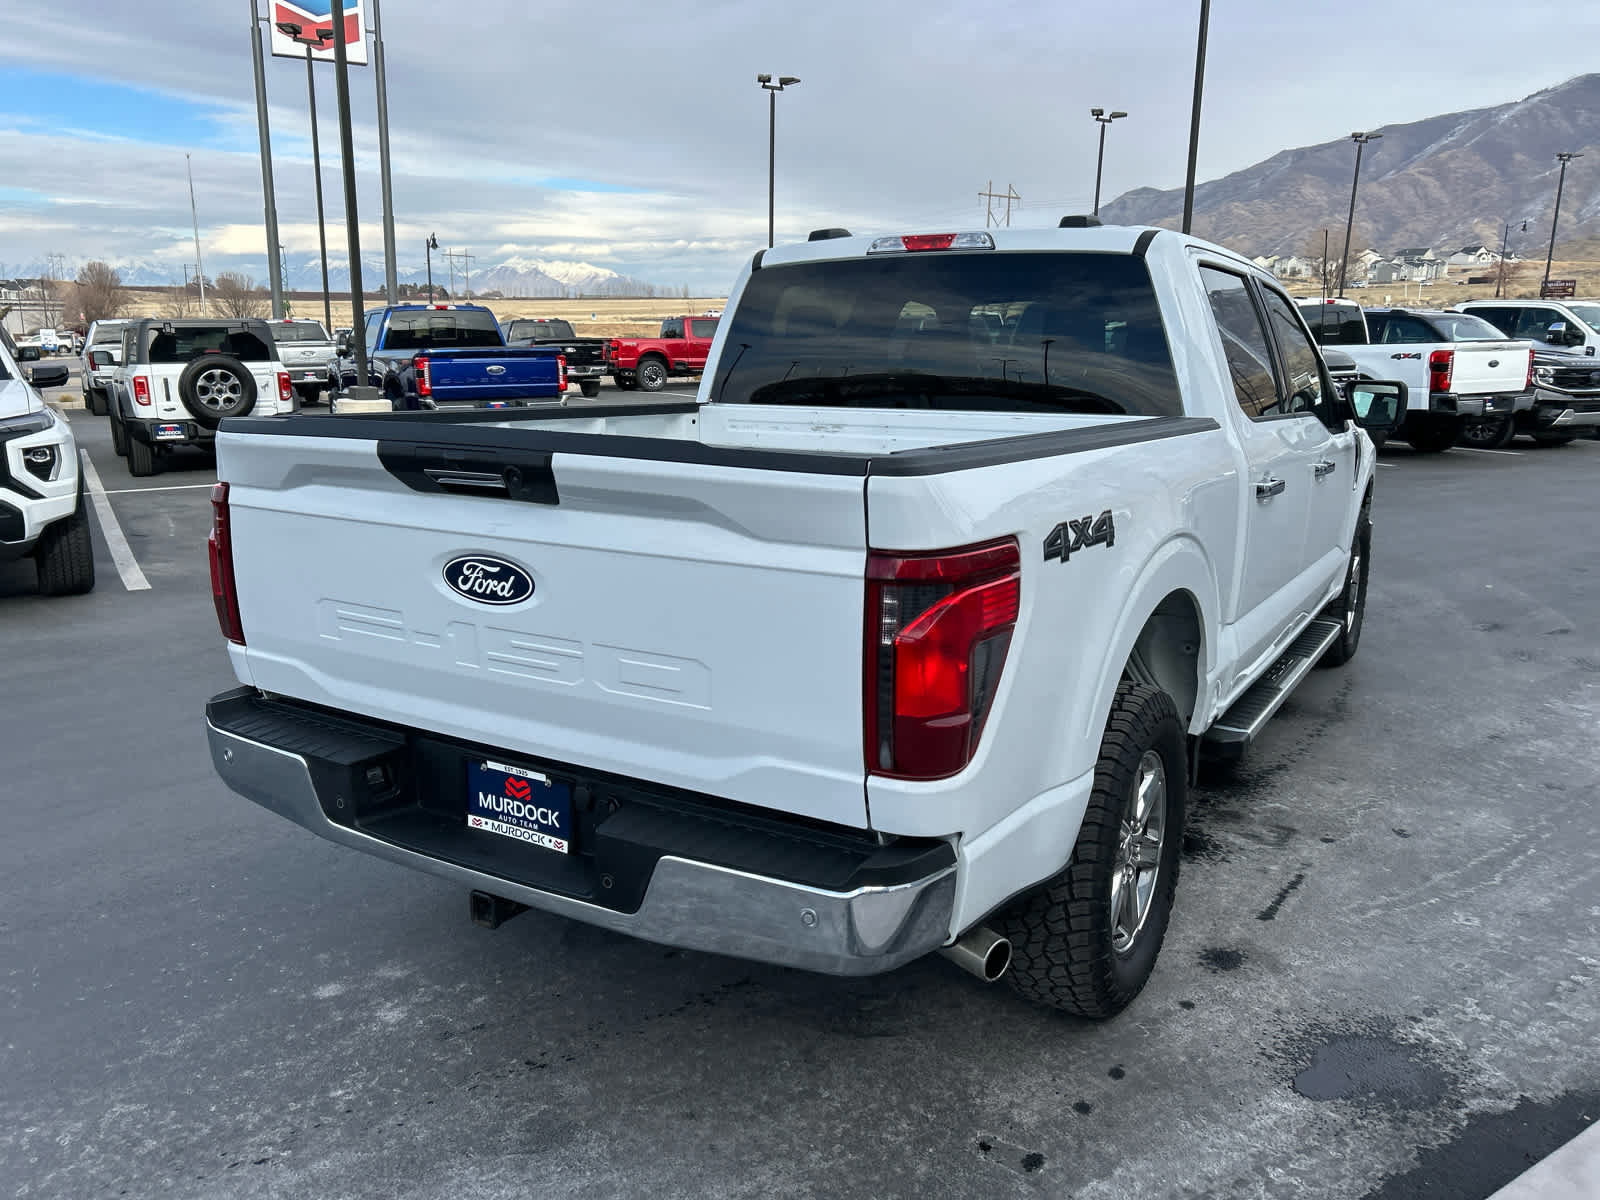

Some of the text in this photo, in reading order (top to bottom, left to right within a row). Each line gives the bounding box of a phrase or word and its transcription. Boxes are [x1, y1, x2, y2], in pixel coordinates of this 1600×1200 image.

[458, 560, 515, 598] Ford
[317, 597, 713, 711] F-150
[479, 792, 560, 828] MURDOCK
[498, 814, 539, 831] AUTO TEAM
[491, 822, 545, 845] MURDOCK
